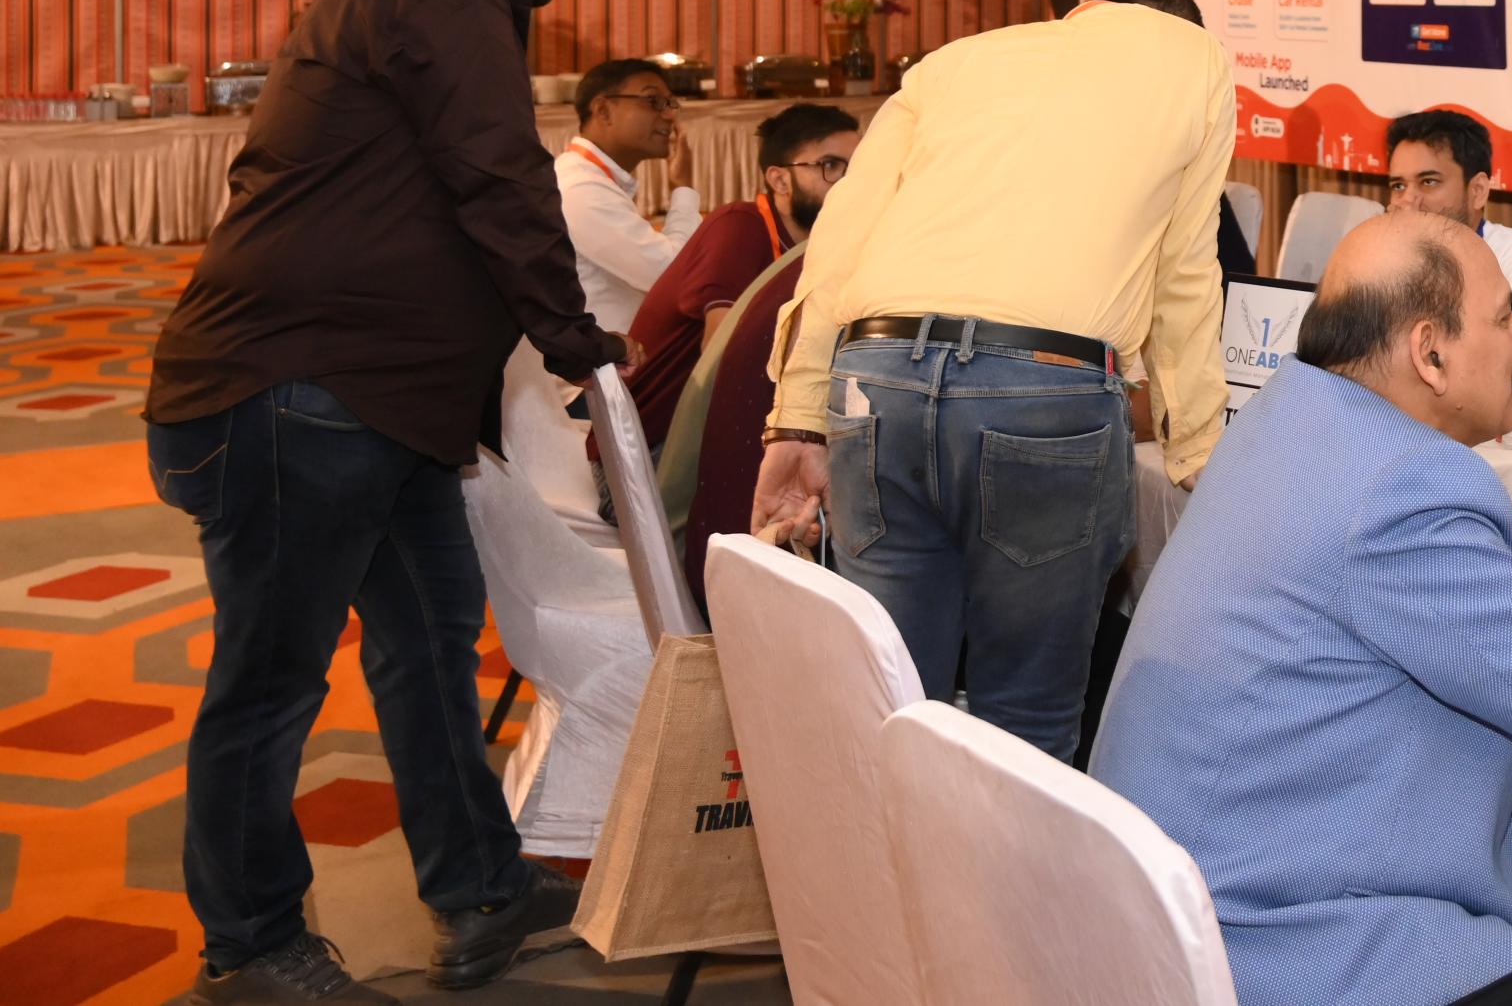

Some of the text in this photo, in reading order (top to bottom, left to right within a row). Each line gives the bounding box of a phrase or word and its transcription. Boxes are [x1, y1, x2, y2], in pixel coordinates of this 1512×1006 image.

[1236, 52, 1293, 73] Mobile App
[1260, 73, 1309, 92] Launched
[1225, 346, 1281, 370] ONEAB
